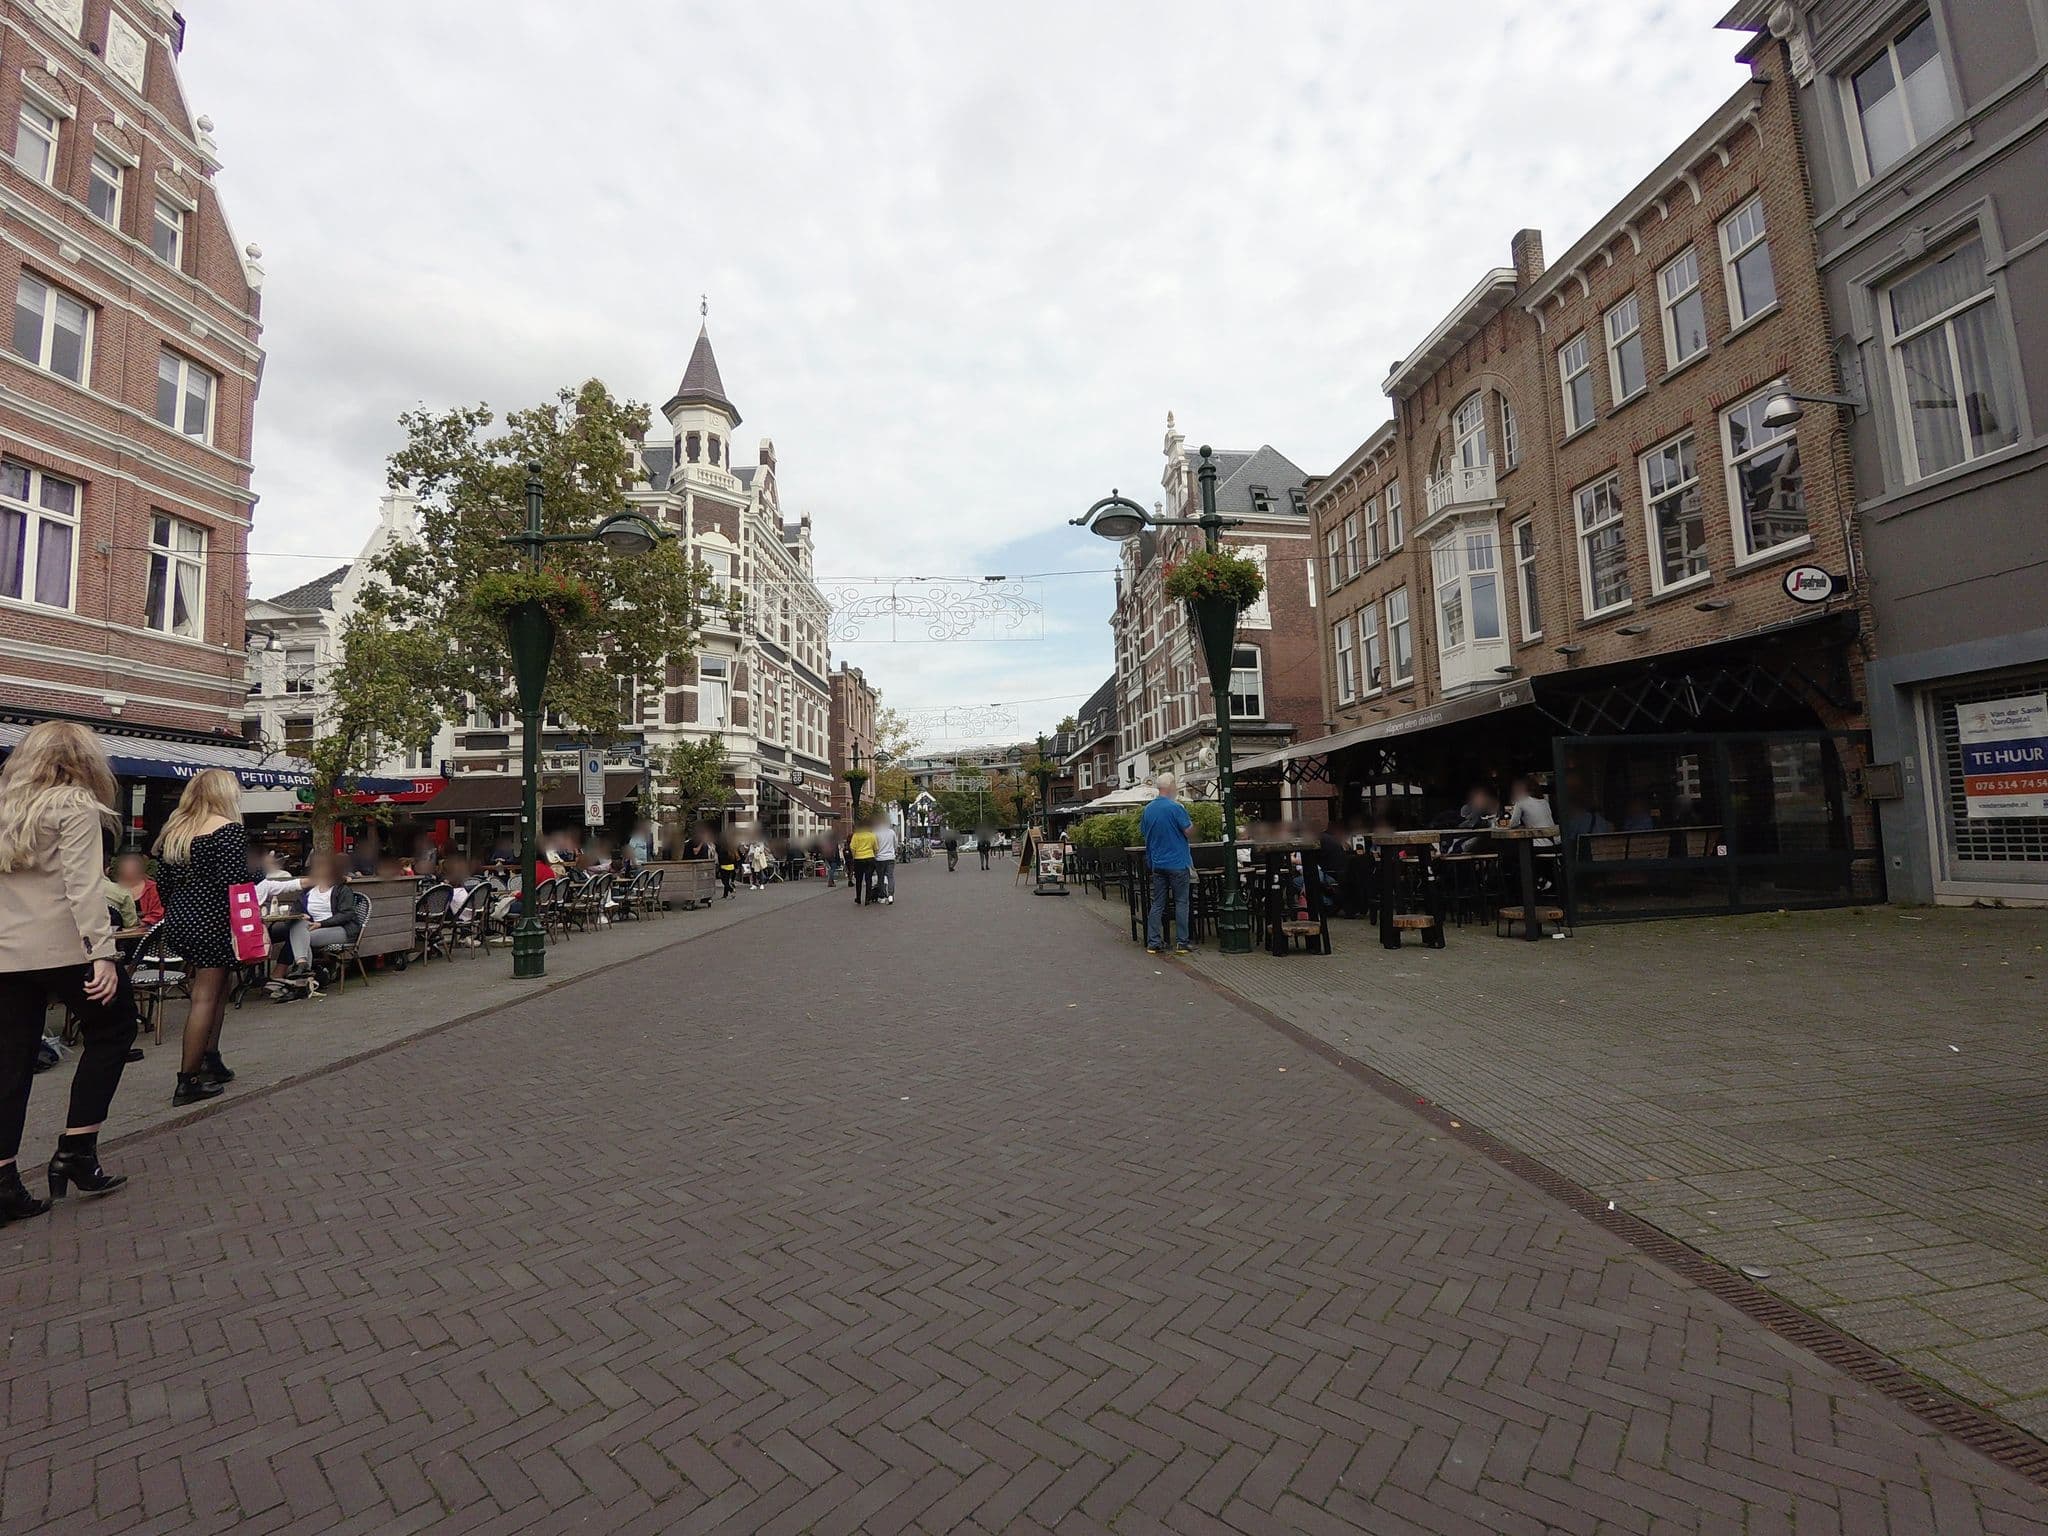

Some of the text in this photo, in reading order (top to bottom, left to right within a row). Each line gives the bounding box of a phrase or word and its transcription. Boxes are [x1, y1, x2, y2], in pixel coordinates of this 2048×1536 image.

[2020, 706, 2043, 714] Sande
[1971, 747, 2045, 766] TE HUUR
[241, 771, 274, 784] PETIT
[1975, 781, 1995, 790] 076
[1998, 780, 2018, 789] 514
[2021, 779, 2034, 788] 74
